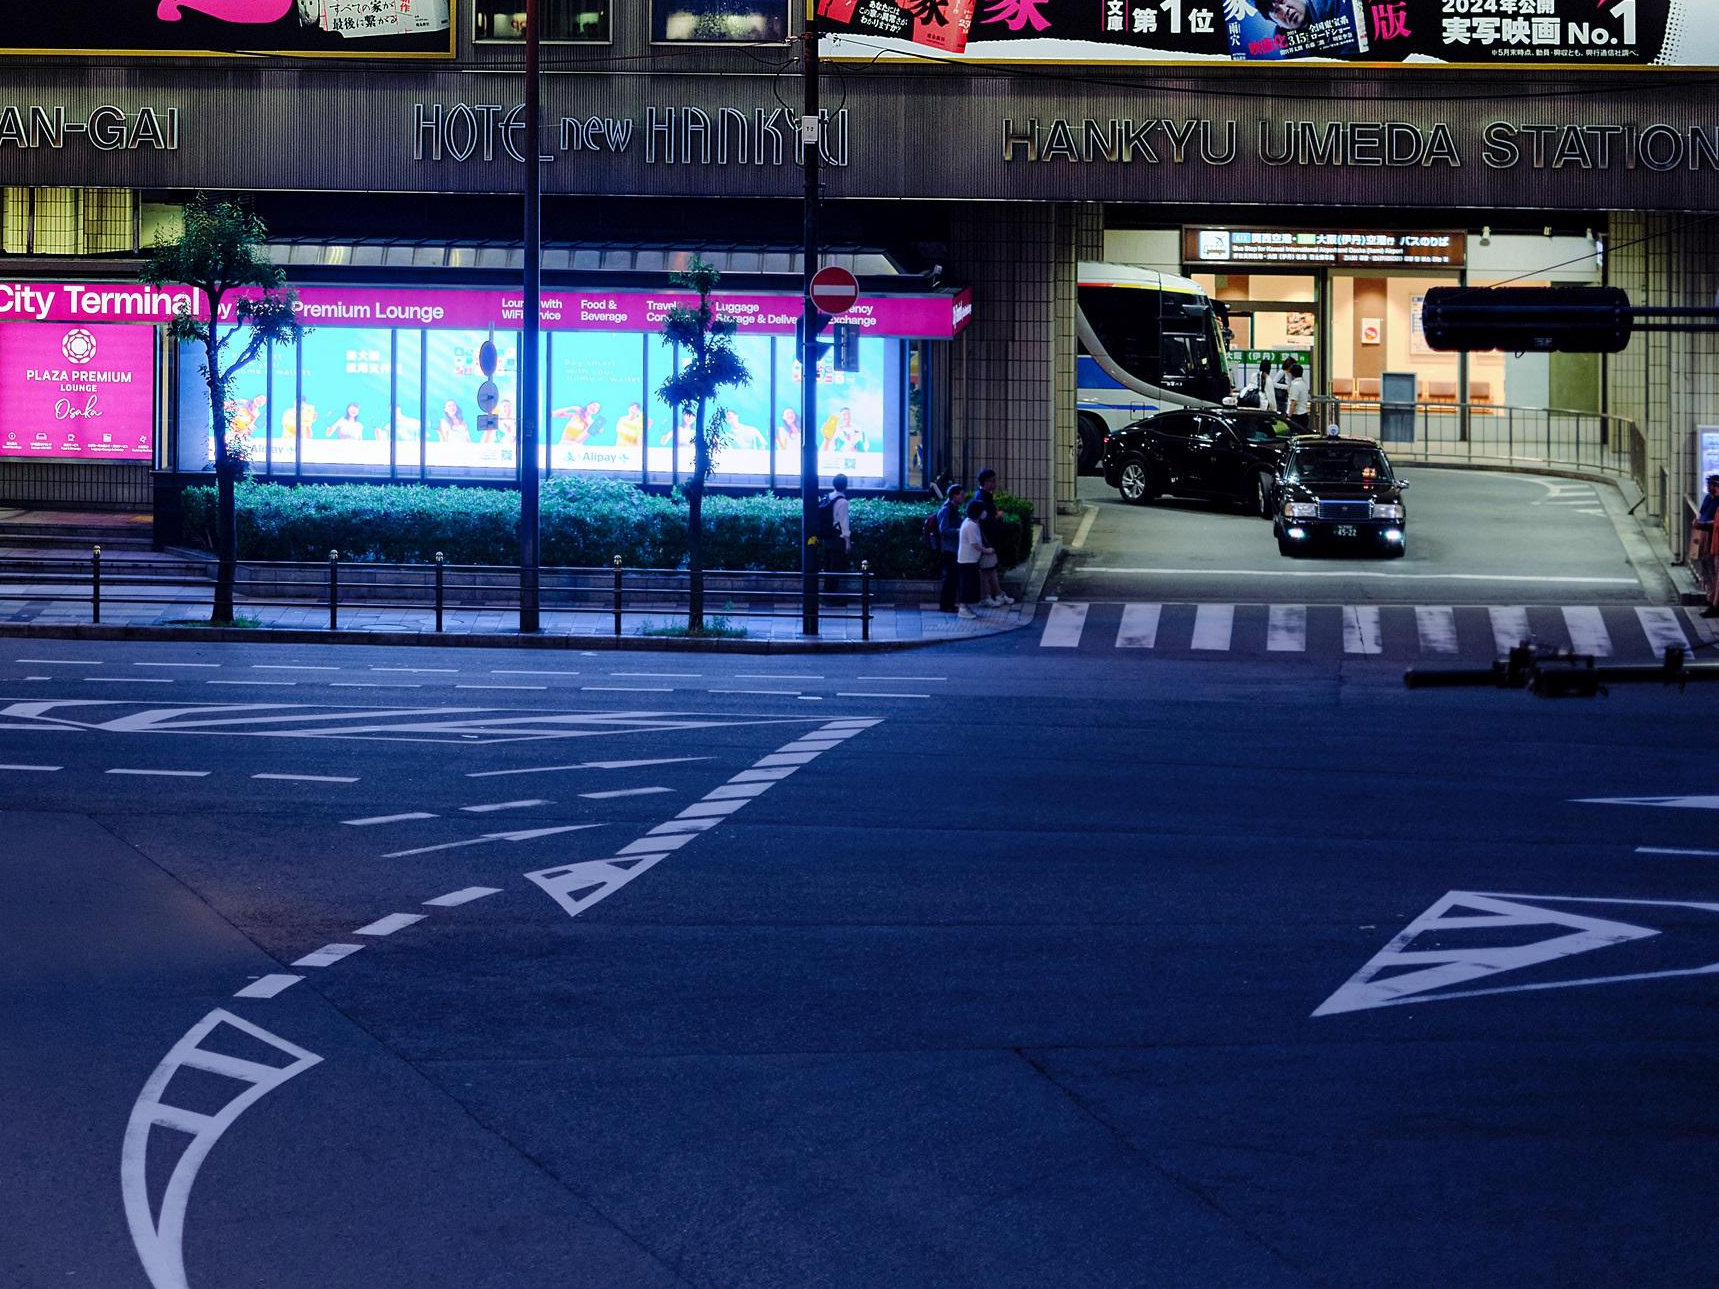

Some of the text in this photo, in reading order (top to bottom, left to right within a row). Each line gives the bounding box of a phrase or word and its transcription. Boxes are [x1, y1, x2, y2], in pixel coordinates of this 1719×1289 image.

[1106, 0, 1124, 31] 文庫
[1441, 0, 1637, 46] 実写映画 No.1
[1228, 22, 1241, 46] 雨穴
[414, 103, 554, 163] HOTE
[560, 116, 633, 153] new
[1002, 118, 1719, 172] HANKYU UMEDA STATION
[1400, 236, 1450, 247] バスのりば
[63, 285, 200, 316] Terminal
[293, 301, 371, 319] Premium
[376, 303, 444, 323] Lounge
[581, 300, 618, 310] Food &
[715, 302, 760, 314] Luggage
[581, 311, 628, 323] Beverage
[768, 314, 798, 325] Delive
[26, 369, 132, 383] PLAZA PREMIUM
[60, 384, 97, 392] LOUNGE
[54, 395, 103, 421] Osaka
